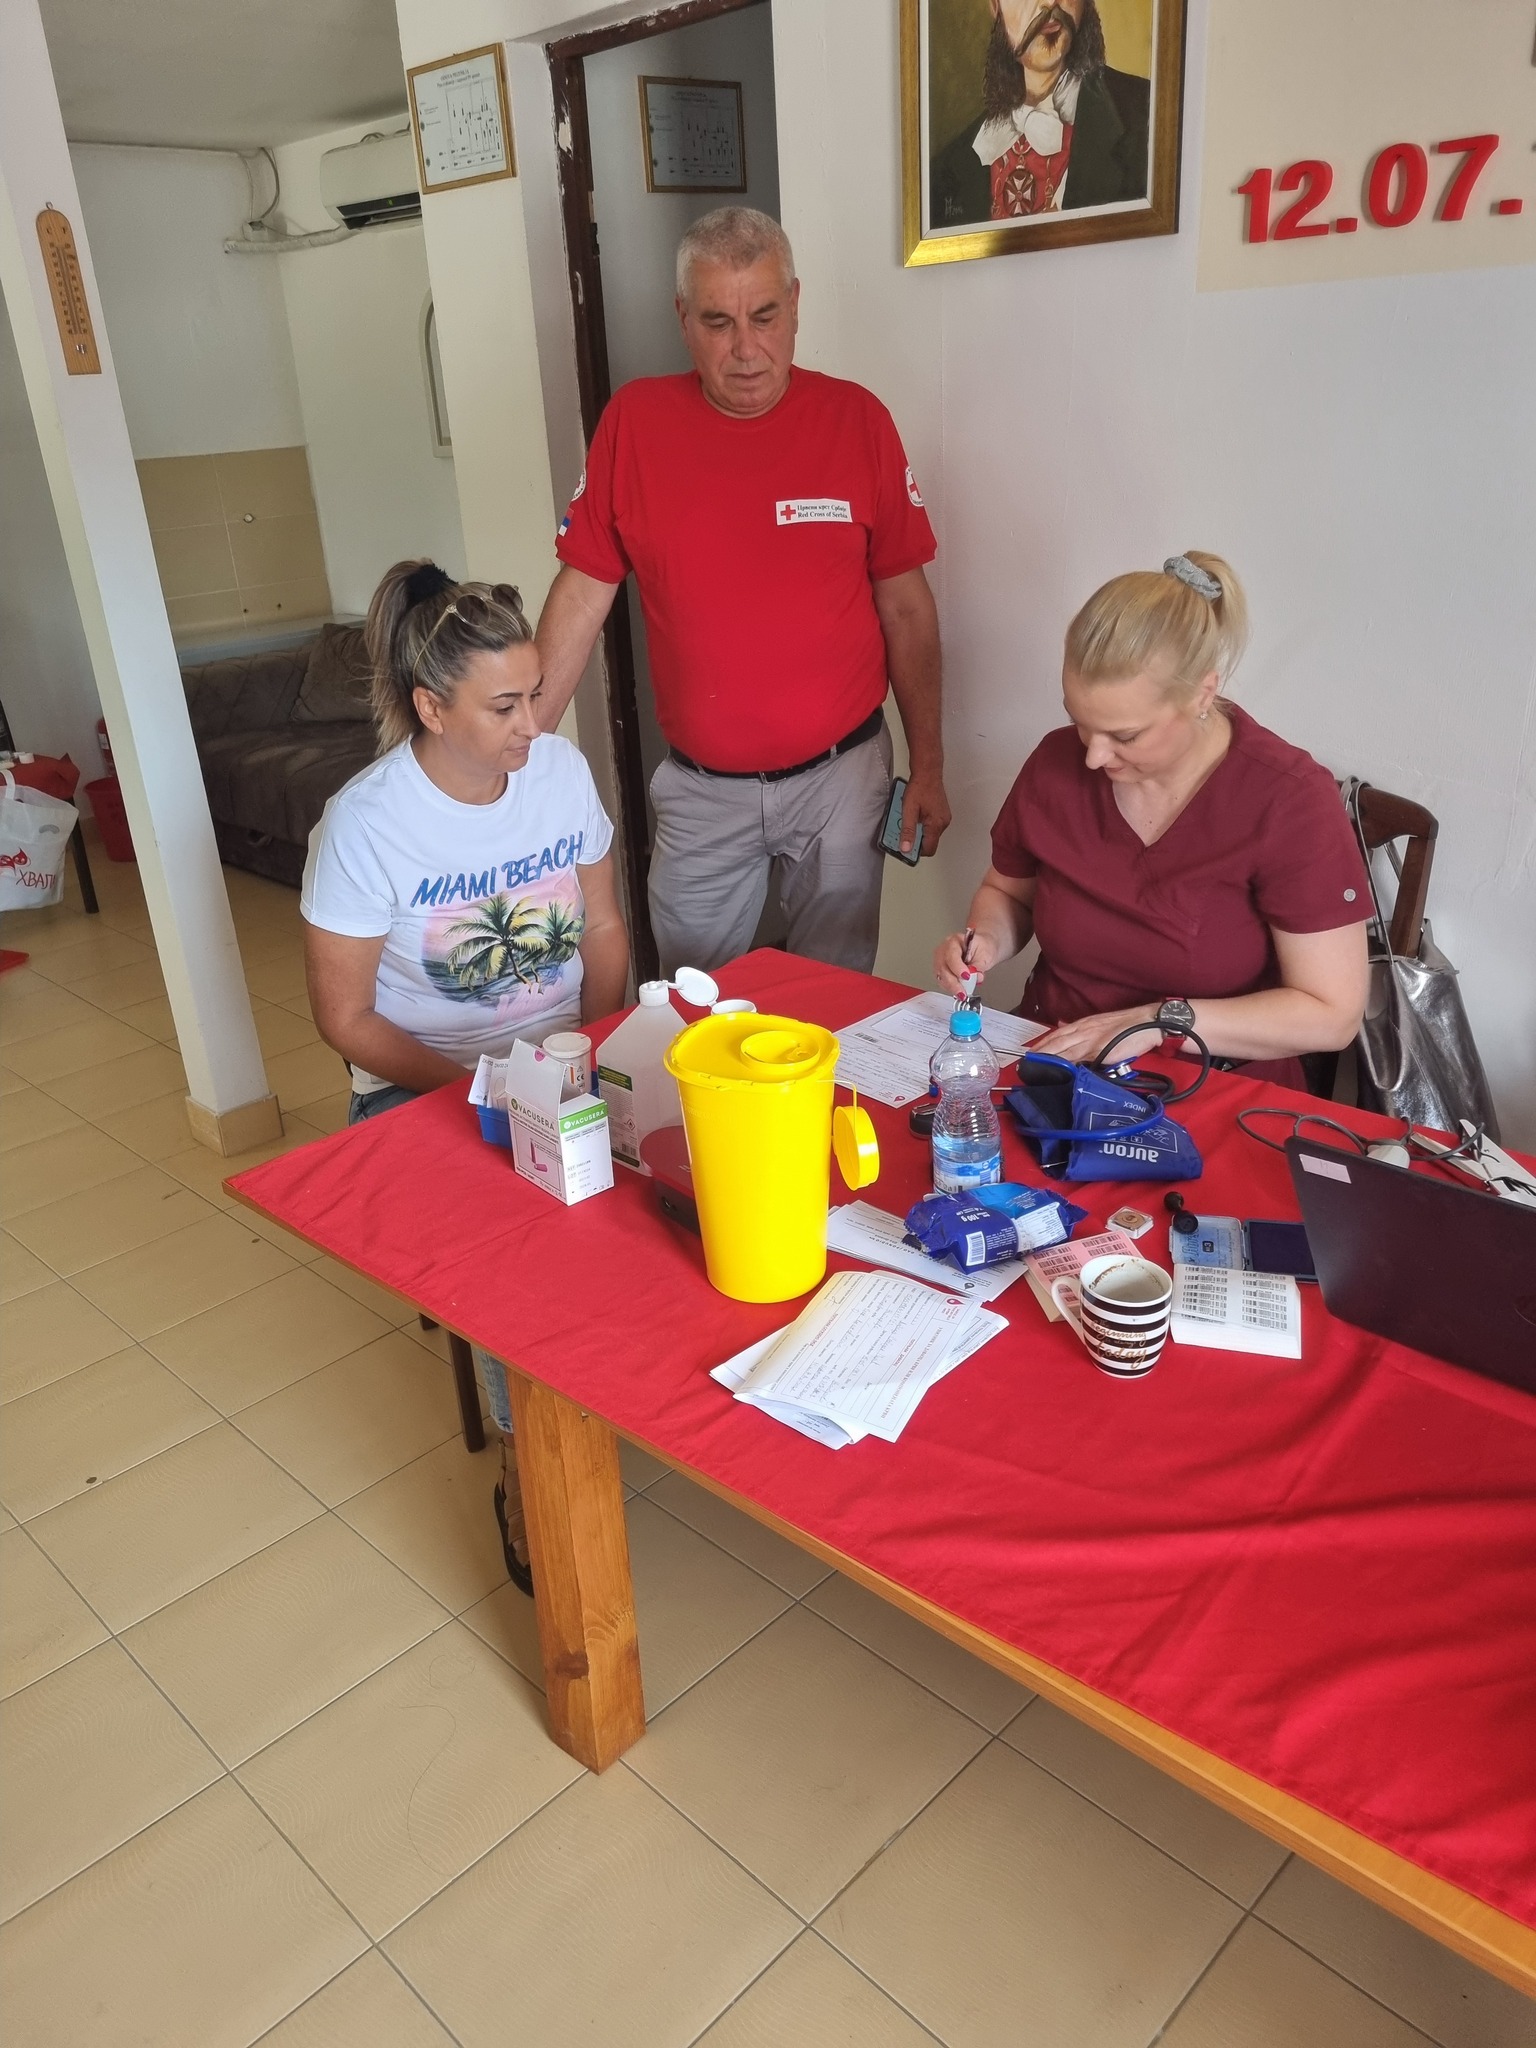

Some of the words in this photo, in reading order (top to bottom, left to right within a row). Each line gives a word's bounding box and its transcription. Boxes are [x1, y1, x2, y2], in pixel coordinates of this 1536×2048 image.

[410, 867, 497, 908] MIAMI
[501, 831, 583, 889] BEACH
[517, 1102, 555, 1132] VACUSERA
[571, 1110, 605, 1127] VACUSERA
[1123, 1101, 1147, 1114] INDEX
[1103, 1143, 1159, 1163] auron
[1097, 1341, 1147, 1370] today
